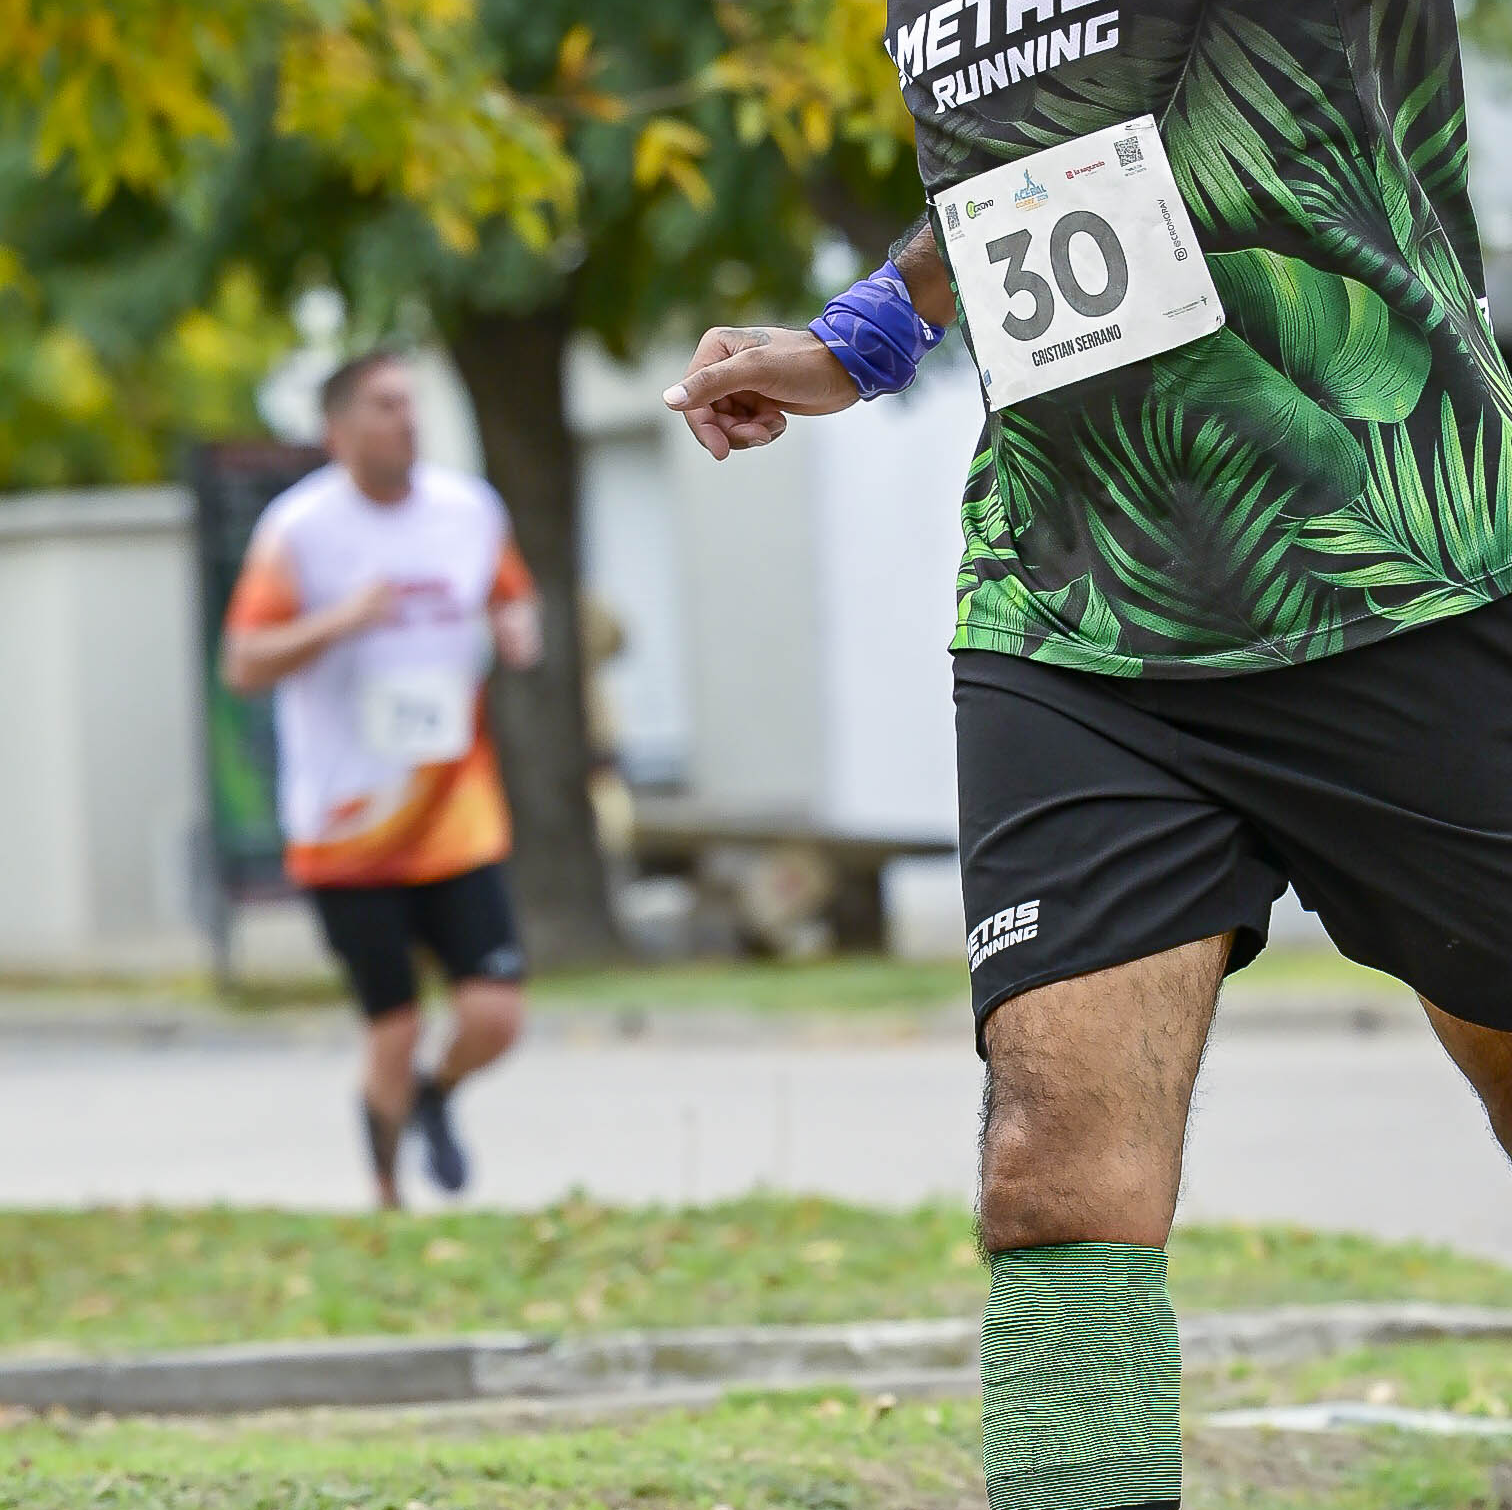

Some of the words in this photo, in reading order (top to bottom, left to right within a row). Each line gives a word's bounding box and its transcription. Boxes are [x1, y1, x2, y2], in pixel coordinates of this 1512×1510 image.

[932, 10, 1119, 114] RUNNING
[986, 211, 1128, 341] 30
[1032, 340, 1075, 367] CRISTIAN
[1075, 324, 1121, 352] SERRANO
[968, 900, 1040, 962] ETAS
